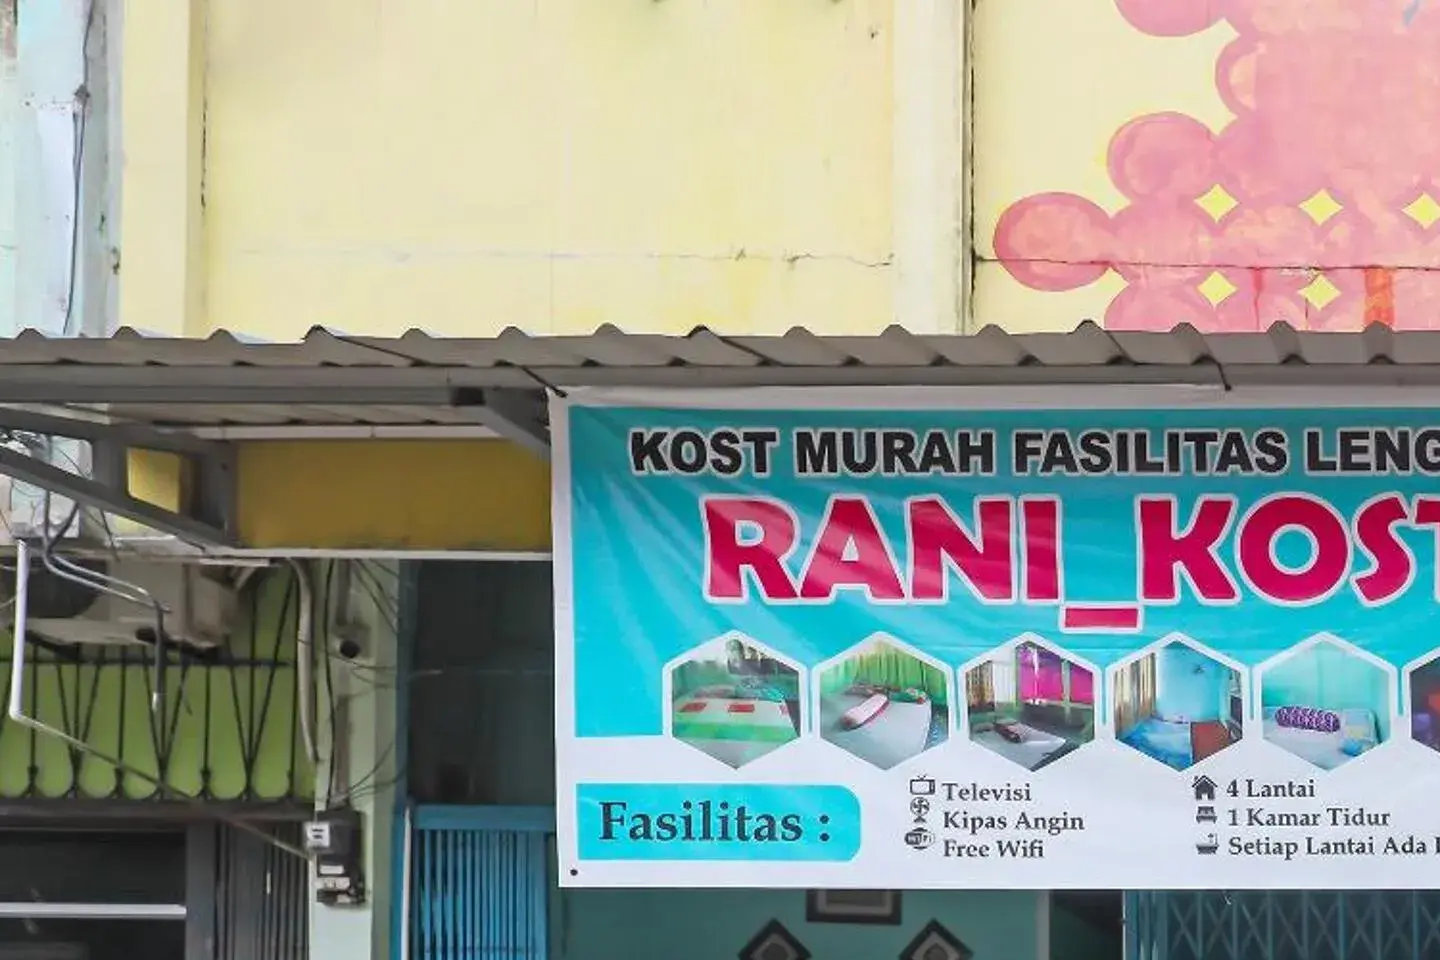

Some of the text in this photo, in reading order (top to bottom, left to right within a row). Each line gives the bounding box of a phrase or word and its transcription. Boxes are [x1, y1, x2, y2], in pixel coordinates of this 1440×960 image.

[632, 430, 776, 474] KOST
[798, 430, 993, 473] MURAH
[1015, 430, 1288, 473] FASILITAS
[942, 783, 1032, 801] Televisi
[1226, 779, 1315, 798] 4 Lantai
[598, 800, 802, 842] Fasilitas
[944, 811, 1085, 836] Kipas Angin
[1228, 807, 1391, 827] 1 Kamar Tidur
[943, 840, 1044, 858] Free Wifi
[1228, 837, 1299, 861] Setiap
[1305, 837, 1375, 855] Lantai
[1383, 836, 1427, 854] Ada
